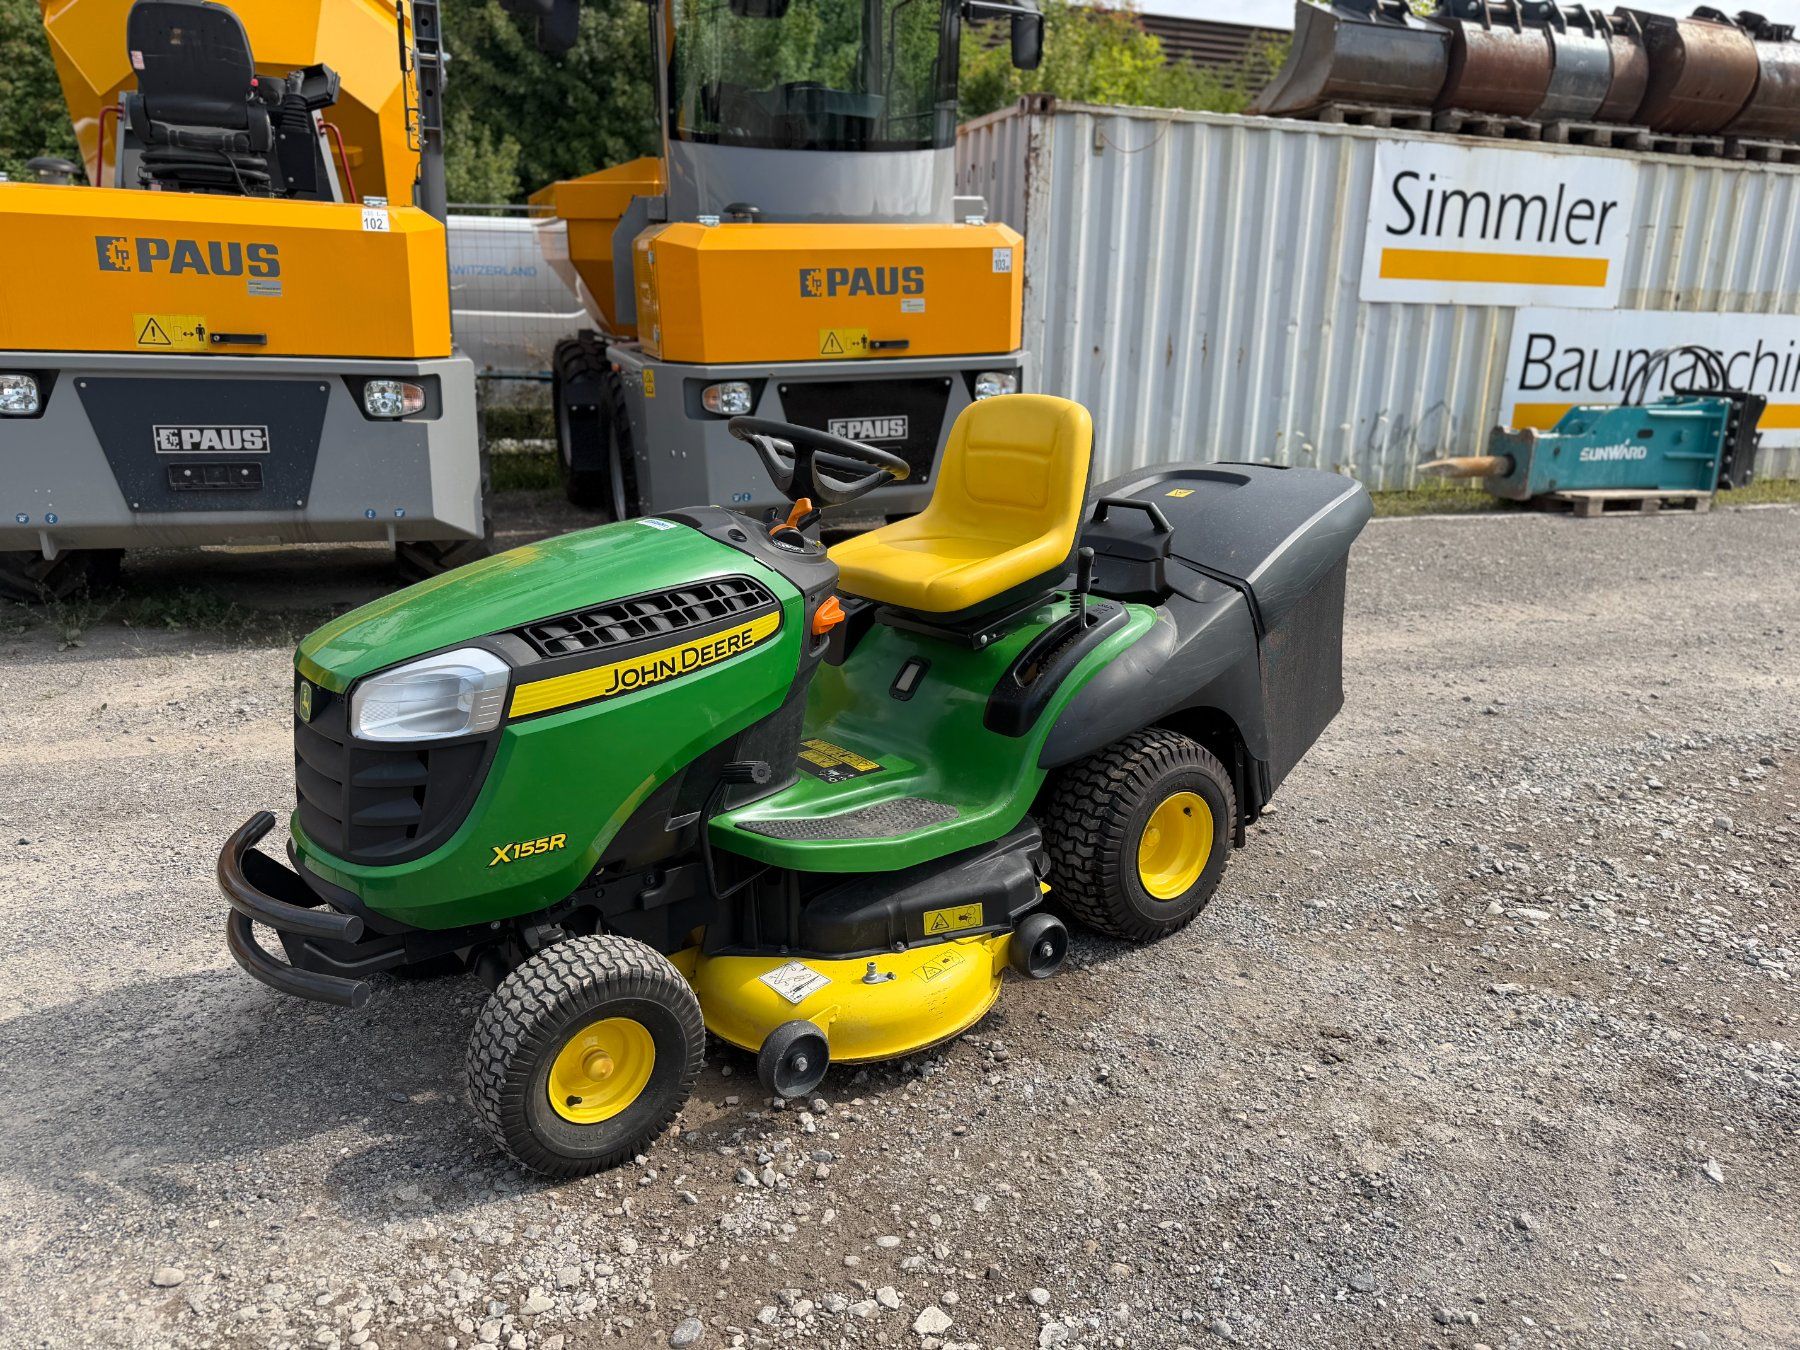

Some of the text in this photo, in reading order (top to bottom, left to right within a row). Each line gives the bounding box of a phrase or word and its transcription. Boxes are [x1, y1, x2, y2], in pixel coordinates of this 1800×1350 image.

[1386, 170, 1617, 246] Simmler
[364, 217, 383, 230] 102
[135, 238, 281, 277] PAUS
[451, 264, 537, 277] WITZERLAND
[827, 266, 924, 297] PAUS
[180, 429, 264, 450] PAUS
[847, 419, 904, 439] PAUS
[1579, 438, 1647, 461] SUNWARD
[605, 628, 753, 693] JOHN DEERE
[488, 833, 567, 867] X155R
